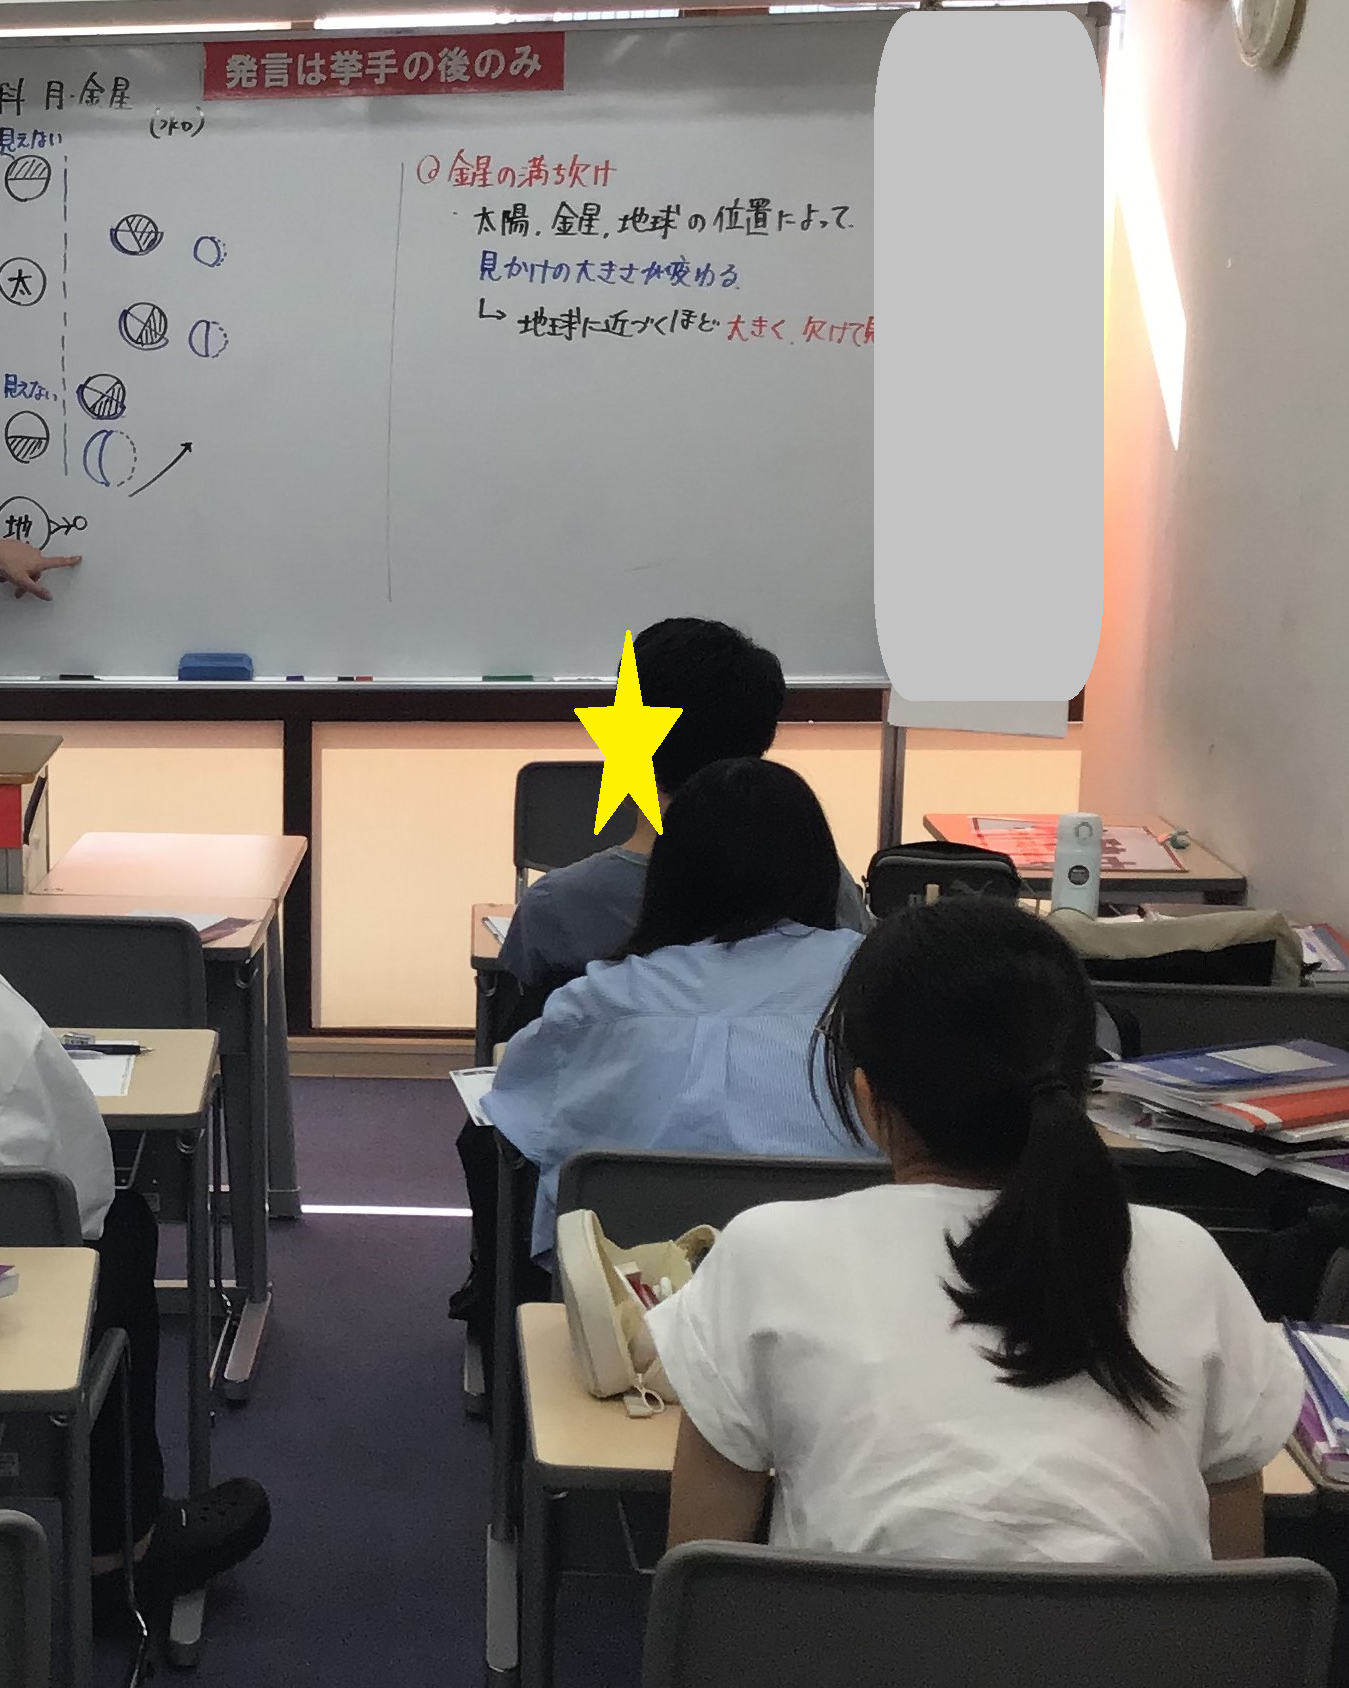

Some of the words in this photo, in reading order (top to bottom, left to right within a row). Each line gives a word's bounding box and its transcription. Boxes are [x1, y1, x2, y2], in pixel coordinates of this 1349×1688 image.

[226, 45, 542, 88] 発言は挙手の後のみ
[0, 127, 62, 152] 見えない
[4, 373, 58, 401] 見えない
